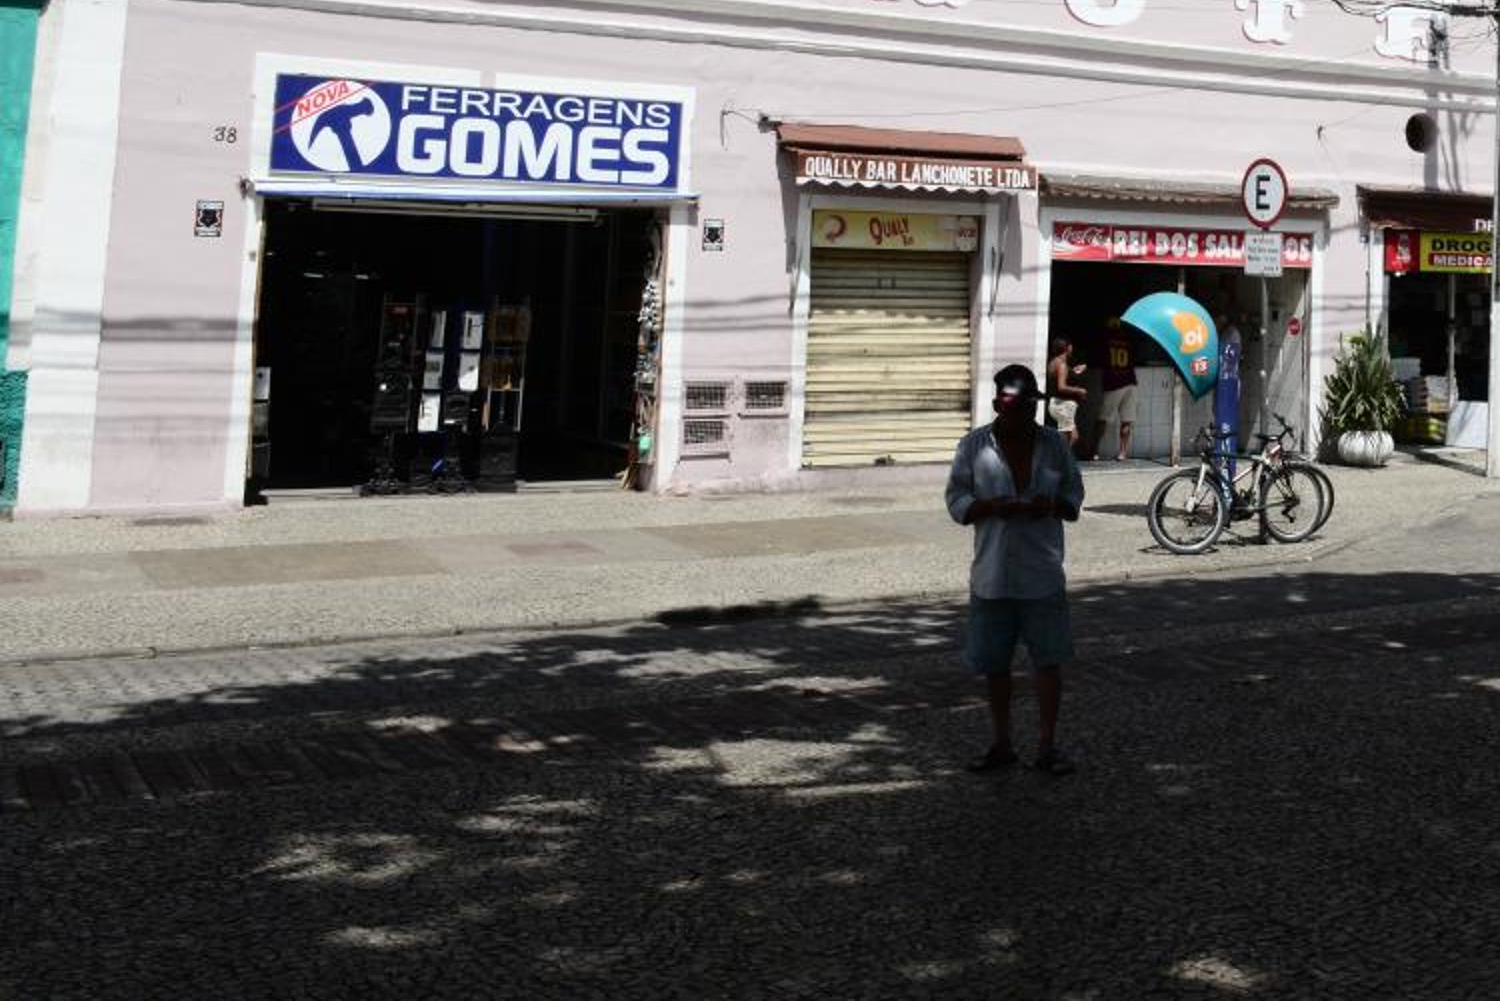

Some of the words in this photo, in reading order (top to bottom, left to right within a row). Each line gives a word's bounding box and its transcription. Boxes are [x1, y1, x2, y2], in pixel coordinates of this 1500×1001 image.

[299, 81, 350, 117] NOVA
[402, 86, 670, 127] FERRAGENS
[397, 114, 669, 185] GOMES
[805, 156, 862, 180] QUALLY
[866, 160, 896, 182] BAR
[902, 162, 992, 187] LANCHONETE
[996, 171, 1031, 189] LTDA
[1255, 174, 1271, 210] E
[1113, 229, 1148, 256] REI
[1154, 231, 1199, 259] DOS
[1202, 232, 1311, 263] SALOS
[1110, 348, 1128, 367] 10
